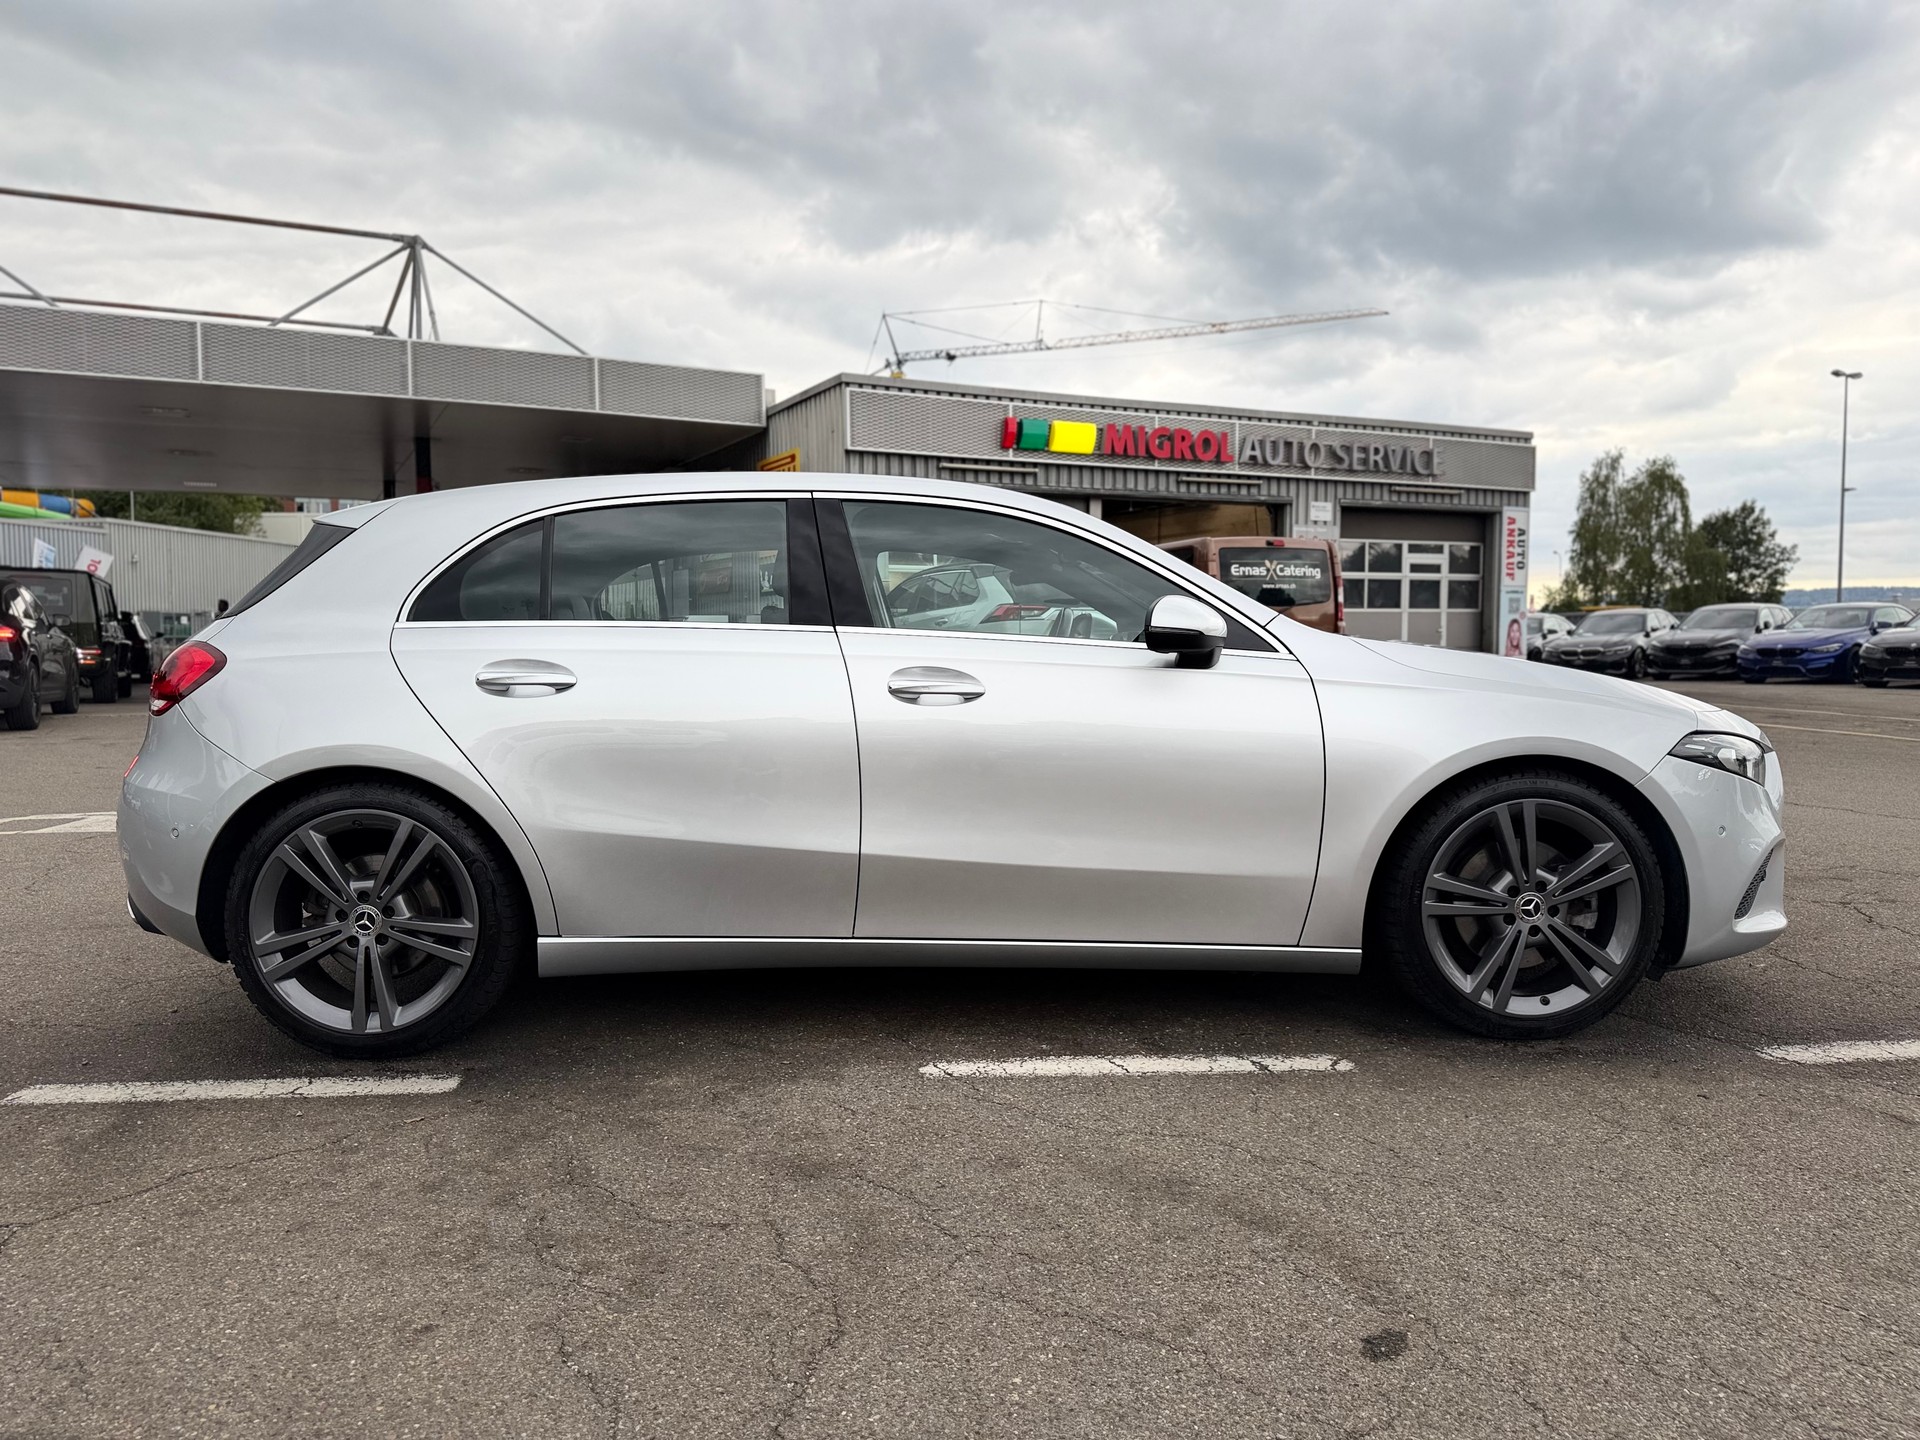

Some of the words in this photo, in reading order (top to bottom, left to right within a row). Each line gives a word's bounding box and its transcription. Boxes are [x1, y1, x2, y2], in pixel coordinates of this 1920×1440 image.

[1104, 422, 1234, 463] MIGROL
[1239, 433, 1326, 469] AUTO
[1335, 442, 1447, 476] SERVICE
[1230, 564, 1267, 576] Ernas
[1276, 563, 1322, 579] Catering
[1505, 516, 1516, 581] ANKAUF
[1517, 527, 1526, 570] AUTO
